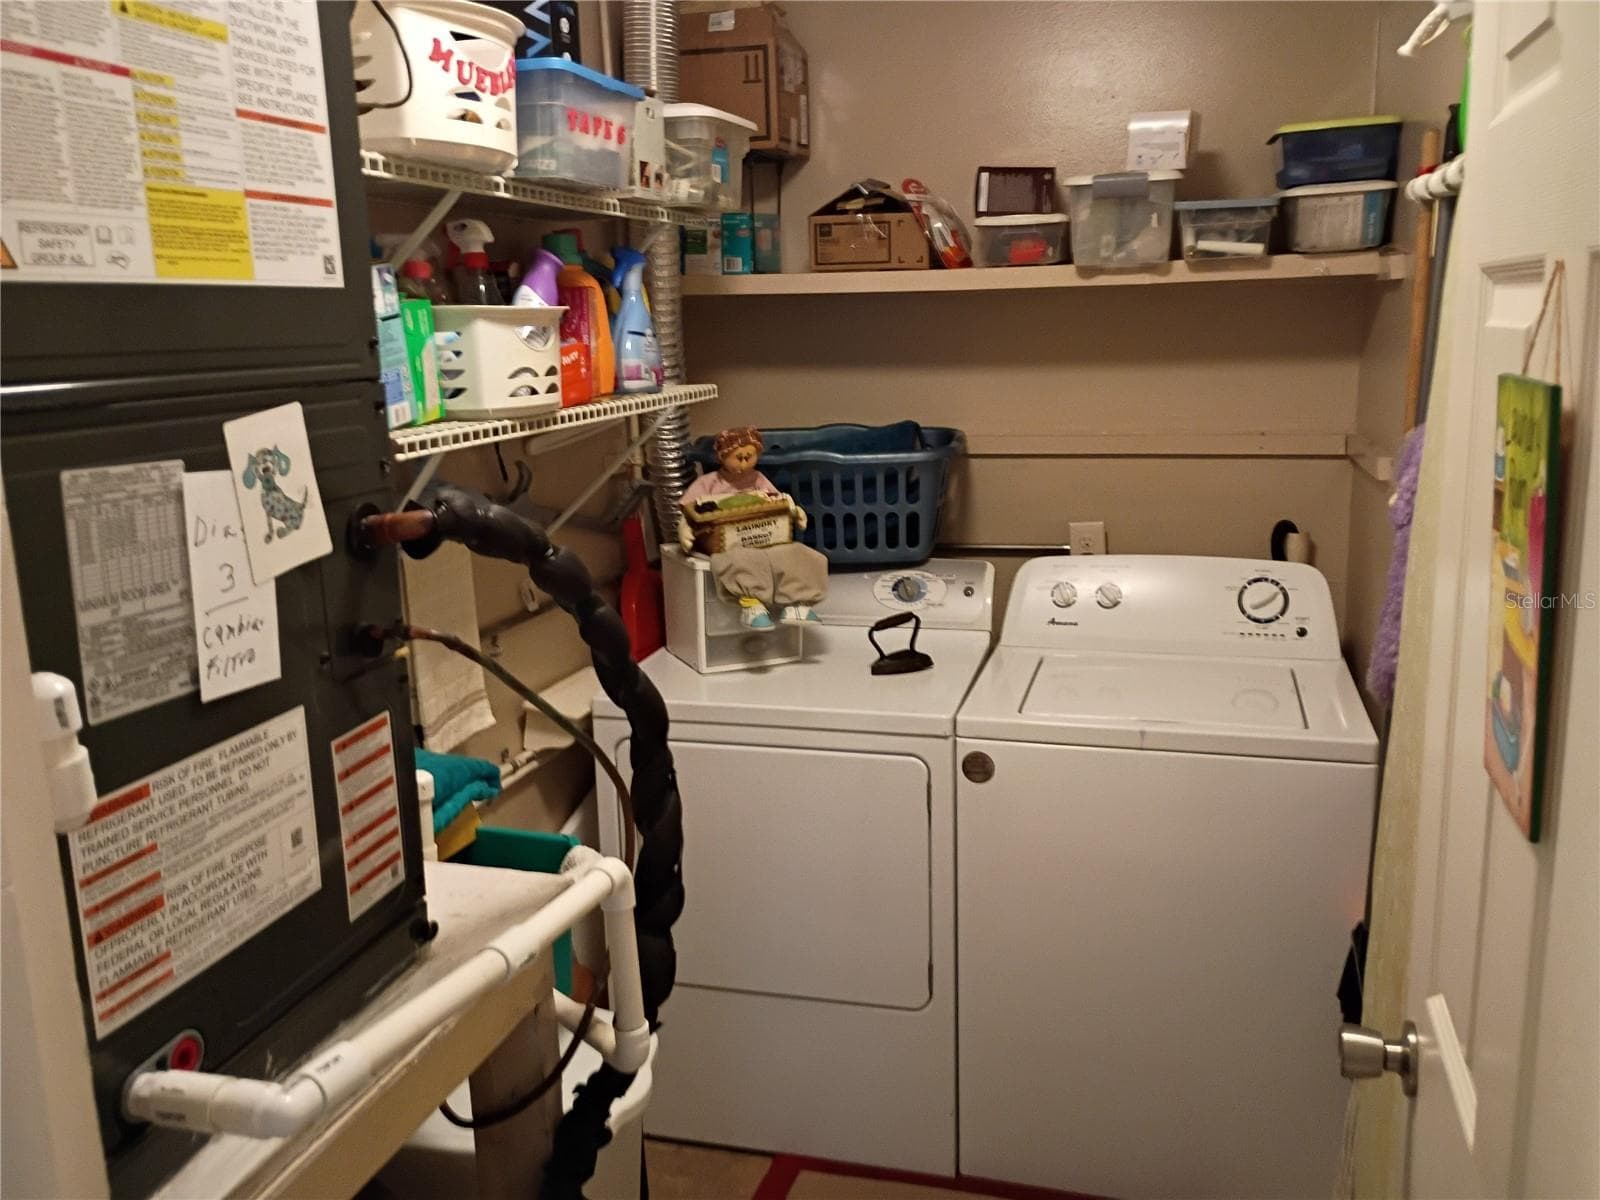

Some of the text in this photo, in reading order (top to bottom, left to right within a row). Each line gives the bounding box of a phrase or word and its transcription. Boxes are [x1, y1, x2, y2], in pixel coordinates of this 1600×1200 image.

[219, 563, 235, 592] 3
[152, 775, 176, 792] RISK
[78, 799, 155, 841] REFRIGERANT
[81, 827, 130, 858] TRAINED
[132, 803, 176, 833] SERVICE
[239, 766, 252, 780] DO
[253, 755, 269, 772] NOT
[82, 838, 142, 874] PUNCTURE
[145, 800, 213, 841] REFRIGERANT
[246, 848, 268, 870] WITH
[167, 884, 189, 901] RISK
[97, 939, 145, 974] FEDERAL
[149, 926, 165, 942] OR
[166, 907, 197, 932] LOCAL
